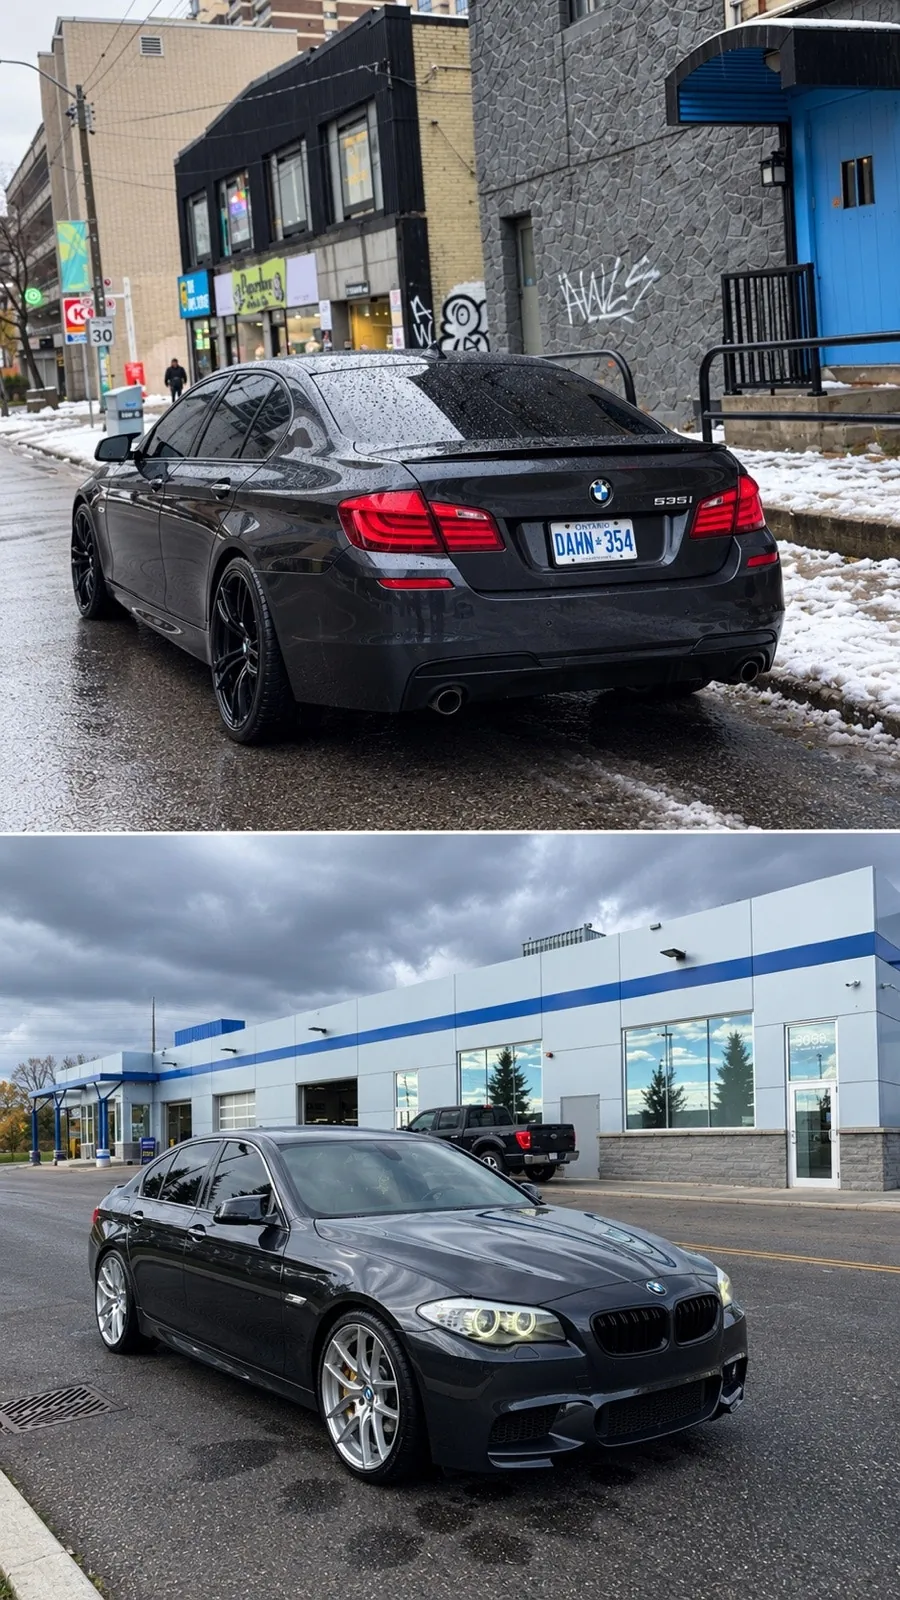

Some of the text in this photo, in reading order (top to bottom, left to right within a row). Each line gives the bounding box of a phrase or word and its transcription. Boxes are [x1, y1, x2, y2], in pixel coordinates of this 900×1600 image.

[92, 329, 112, 342] 30
[575, 522, 610, 531] ONTARIO
[554, 529, 633, 556] DAHN 354
